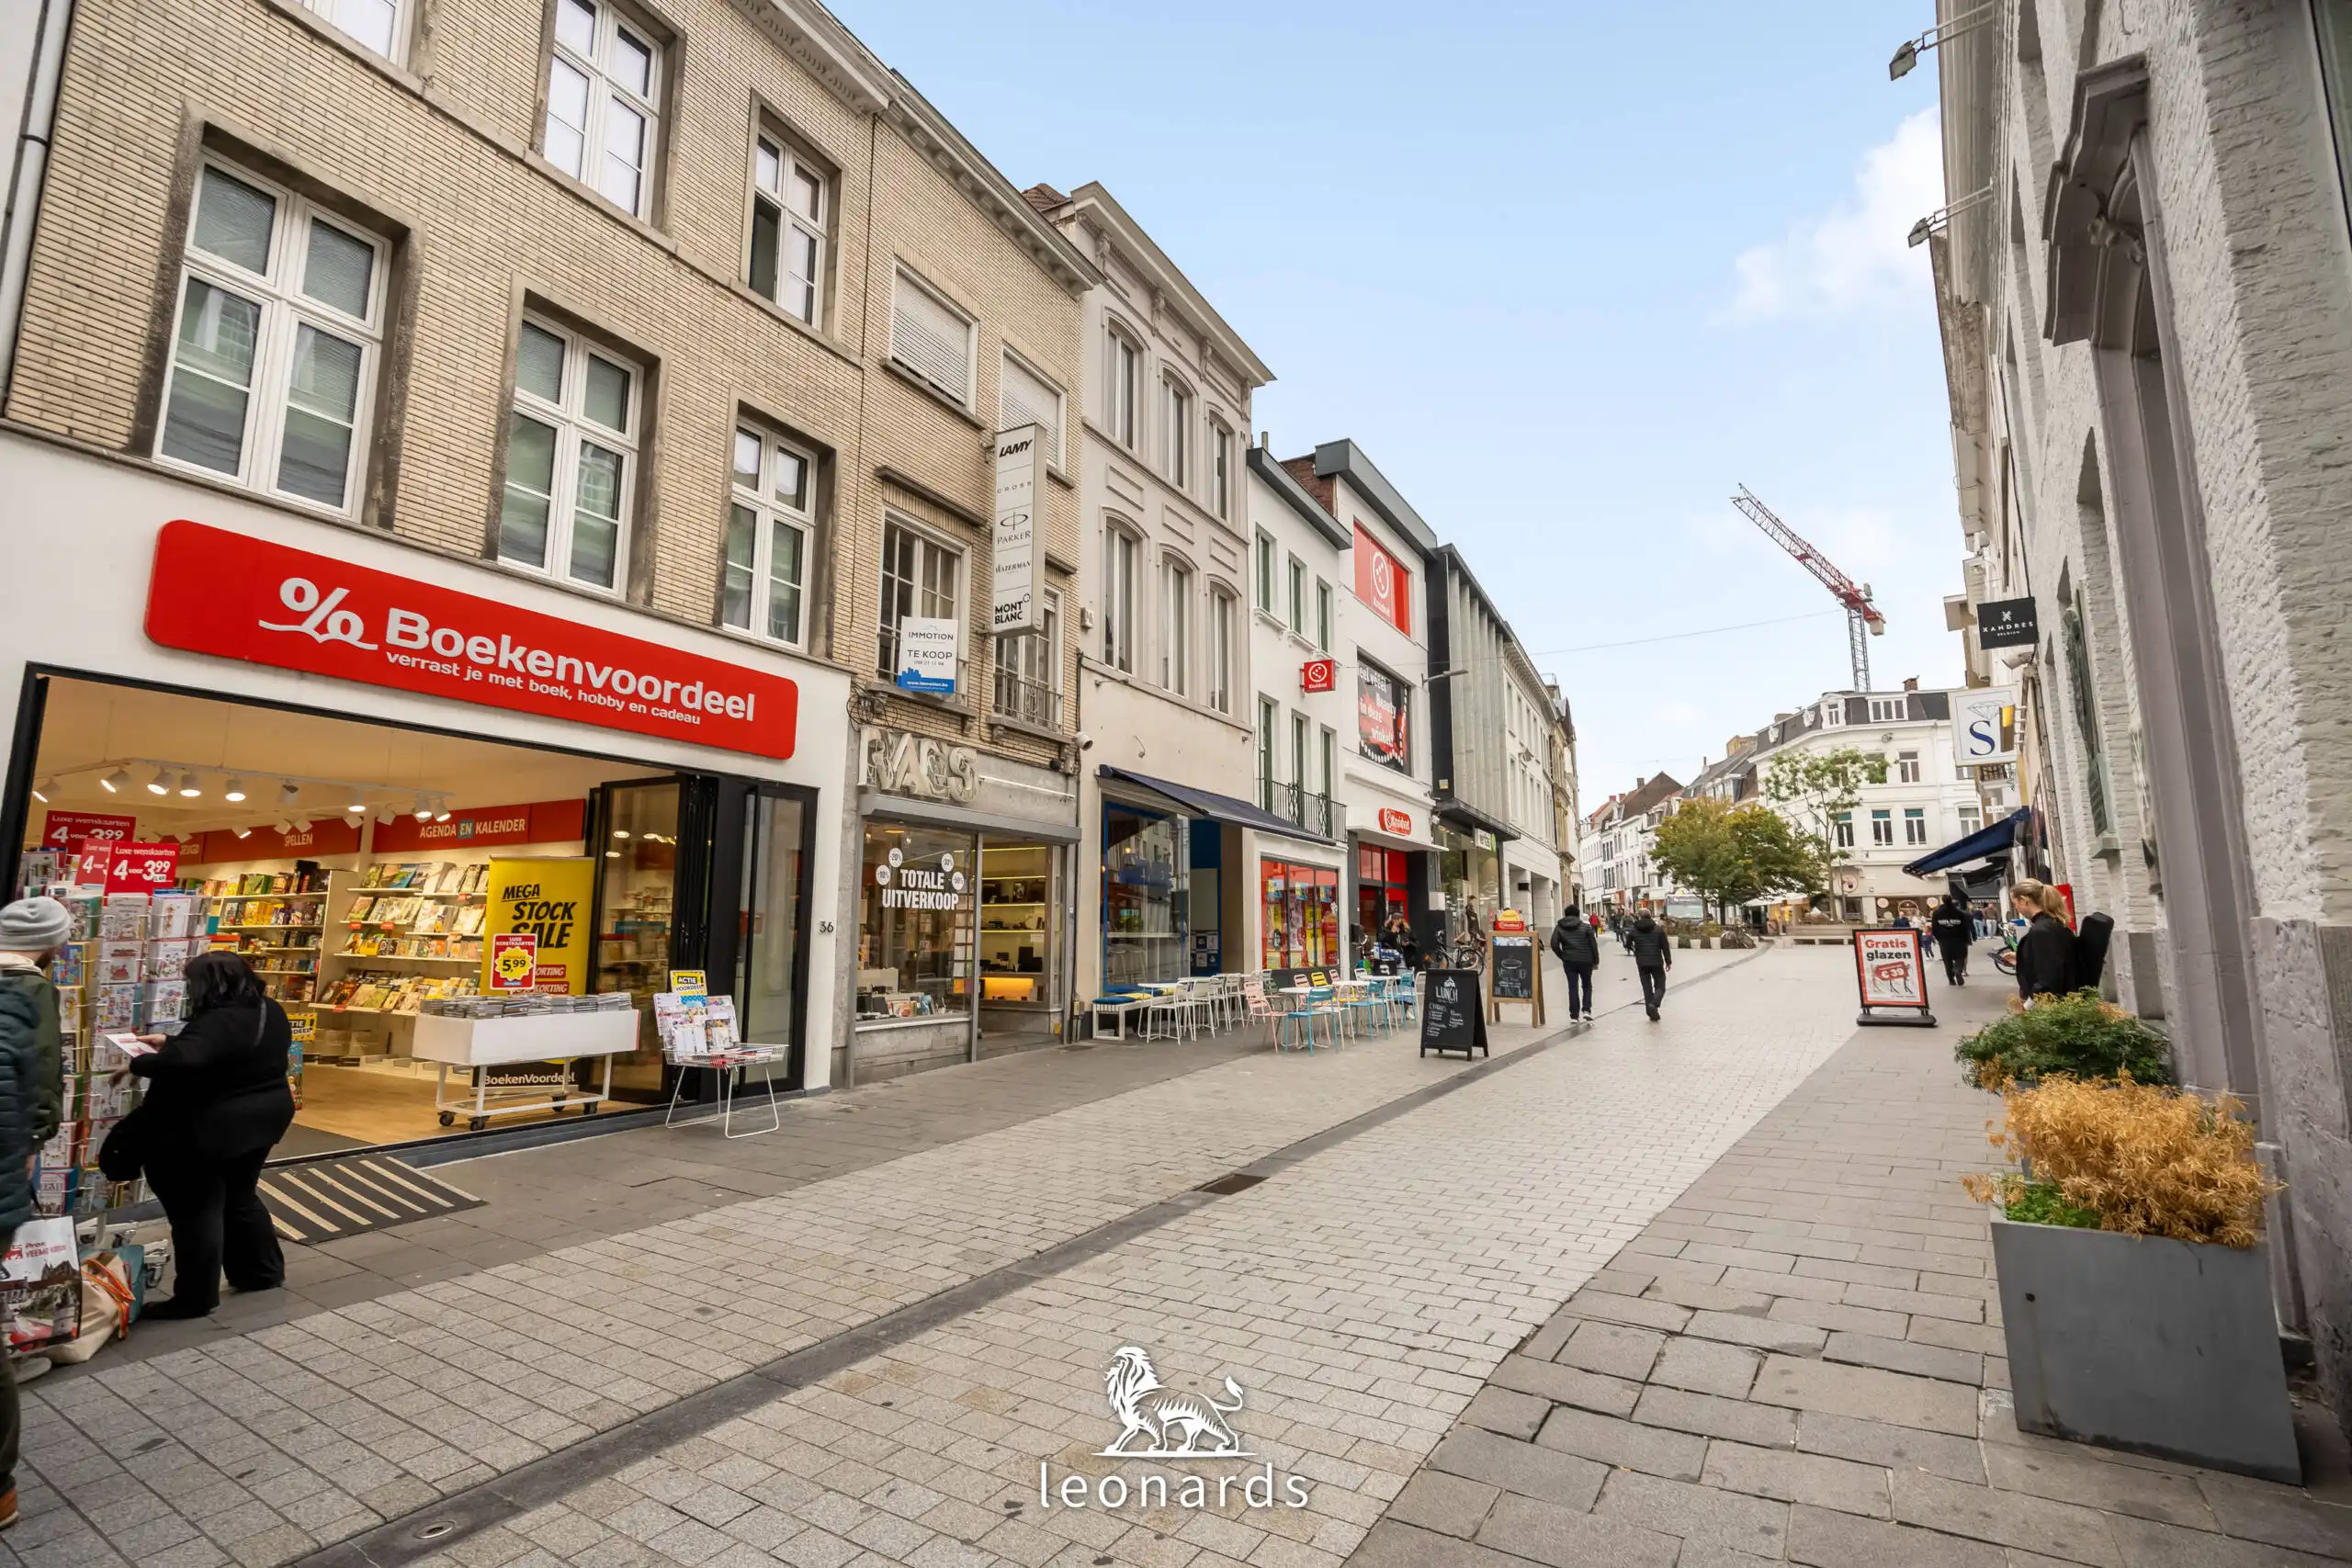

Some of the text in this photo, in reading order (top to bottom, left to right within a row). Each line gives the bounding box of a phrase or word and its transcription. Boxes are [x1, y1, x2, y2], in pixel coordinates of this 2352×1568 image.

[999, 439, 1033, 457] LAMY
[997, 480, 1032, 494] CROSS
[997, 530, 1031, 545] PARKER
[994, 601, 1023, 615] MONT
[994, 611, 1023, 625] BLANC
[1983, 621, 2033, 632] XANDRES
[908, 631, 954, 640] IMMOTION
[907, 649, 953, 660] TE KOOP
[385, 607, 755, 722] Boekenvoordeel
[386, 651, 701, 726] verrast je met boek, hobby en cadeau
[1969, 719, 1996, 756] S
[51, 826, 69, 843] 4
[419, 818, 526, 839] AGENDA EN KALENDER
[284, 833, 313, 847] SPELLEN
[82, 855, 95, 874] 4
[112, 859, 129, 881] 4
[899, 868, 945, 890] TOTALE
[503, 884, 540, 899] MEGA
[882, 888, 959, 910] UITVERKOOP
[511, 900, 577, 920] STOCK
[819, 920, 834, 933] 36
[1864, 938, 1908, 949] Gratis
[1866, 949, 1912, 962] glazen
[536, 966, 565, 976] ORTING
[484, 1071, 575, 1086] BoekenVoordel
